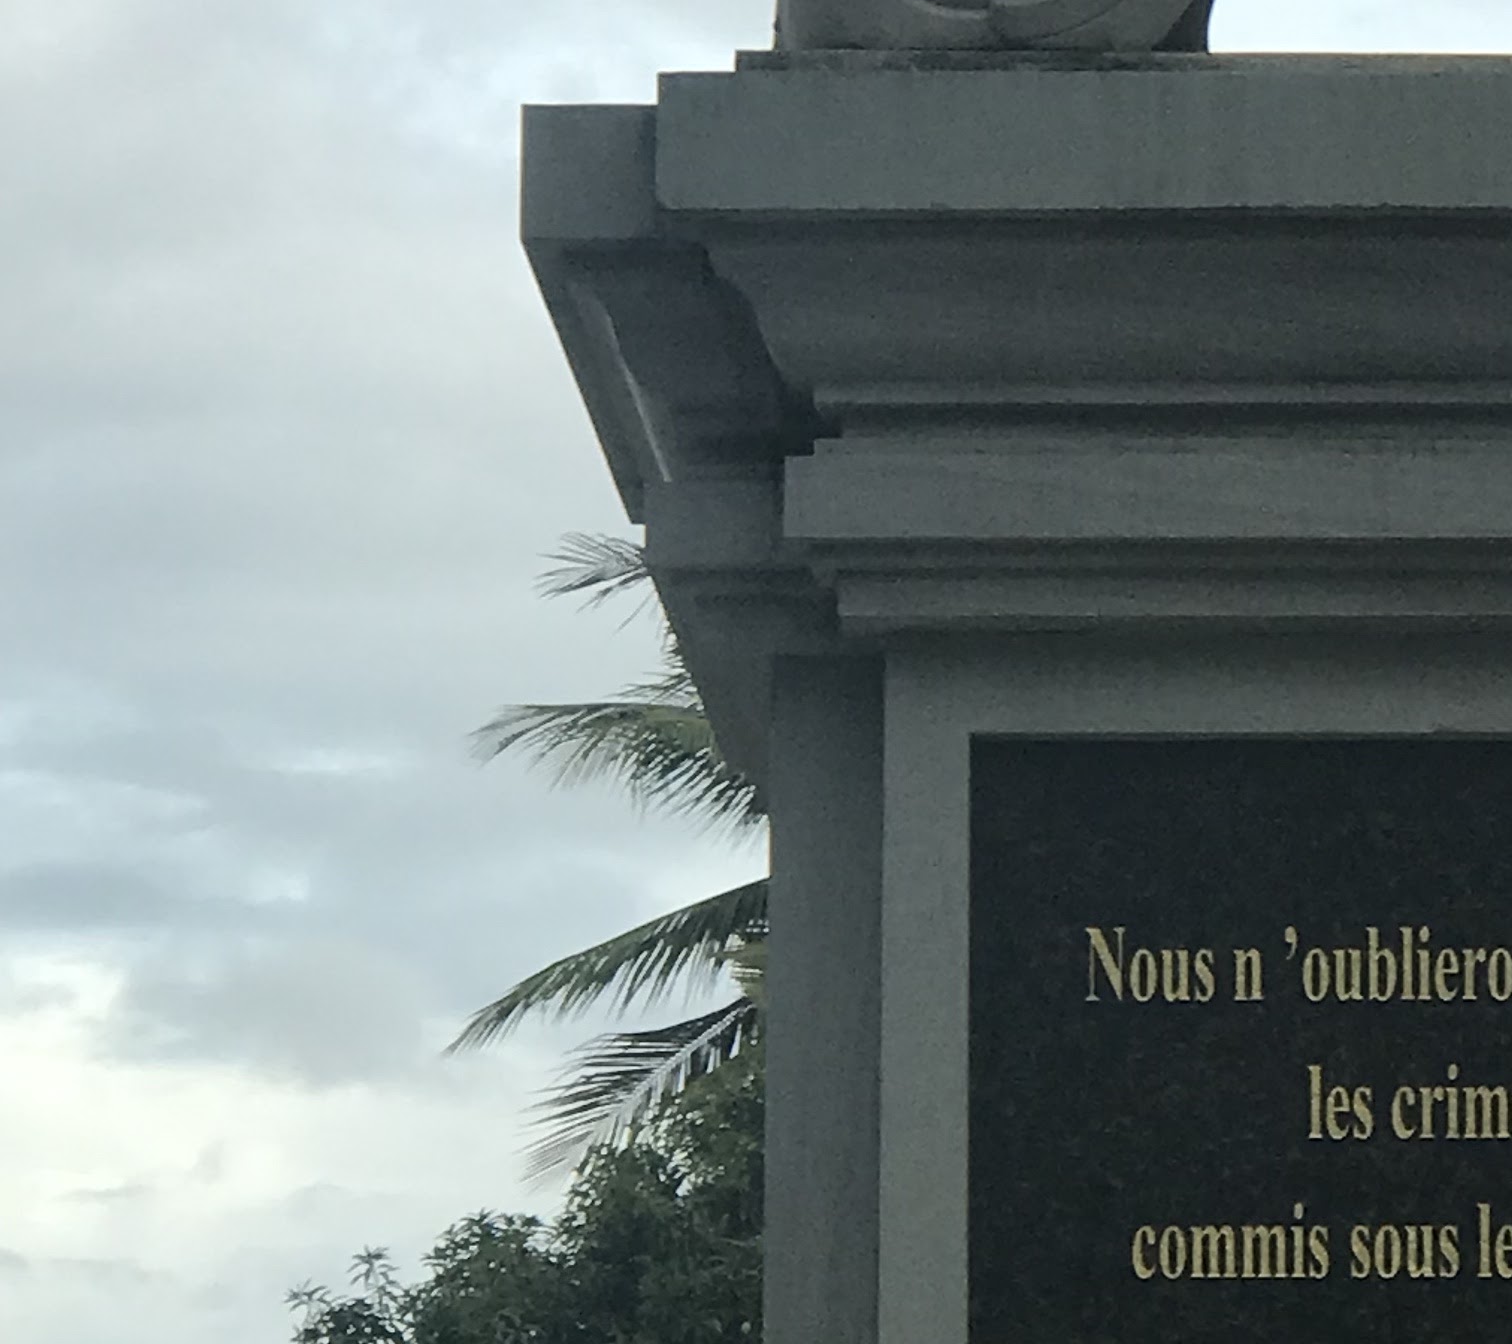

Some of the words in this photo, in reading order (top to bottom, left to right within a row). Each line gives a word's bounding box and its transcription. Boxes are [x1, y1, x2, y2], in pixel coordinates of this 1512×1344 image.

[1085, 926, 1215, 1002] Nous
[1307, 1065, 1373, 1140] les
[1131, 1202, 1329, 1279] commis
[1350, 1225, 1460, 1279] sous
